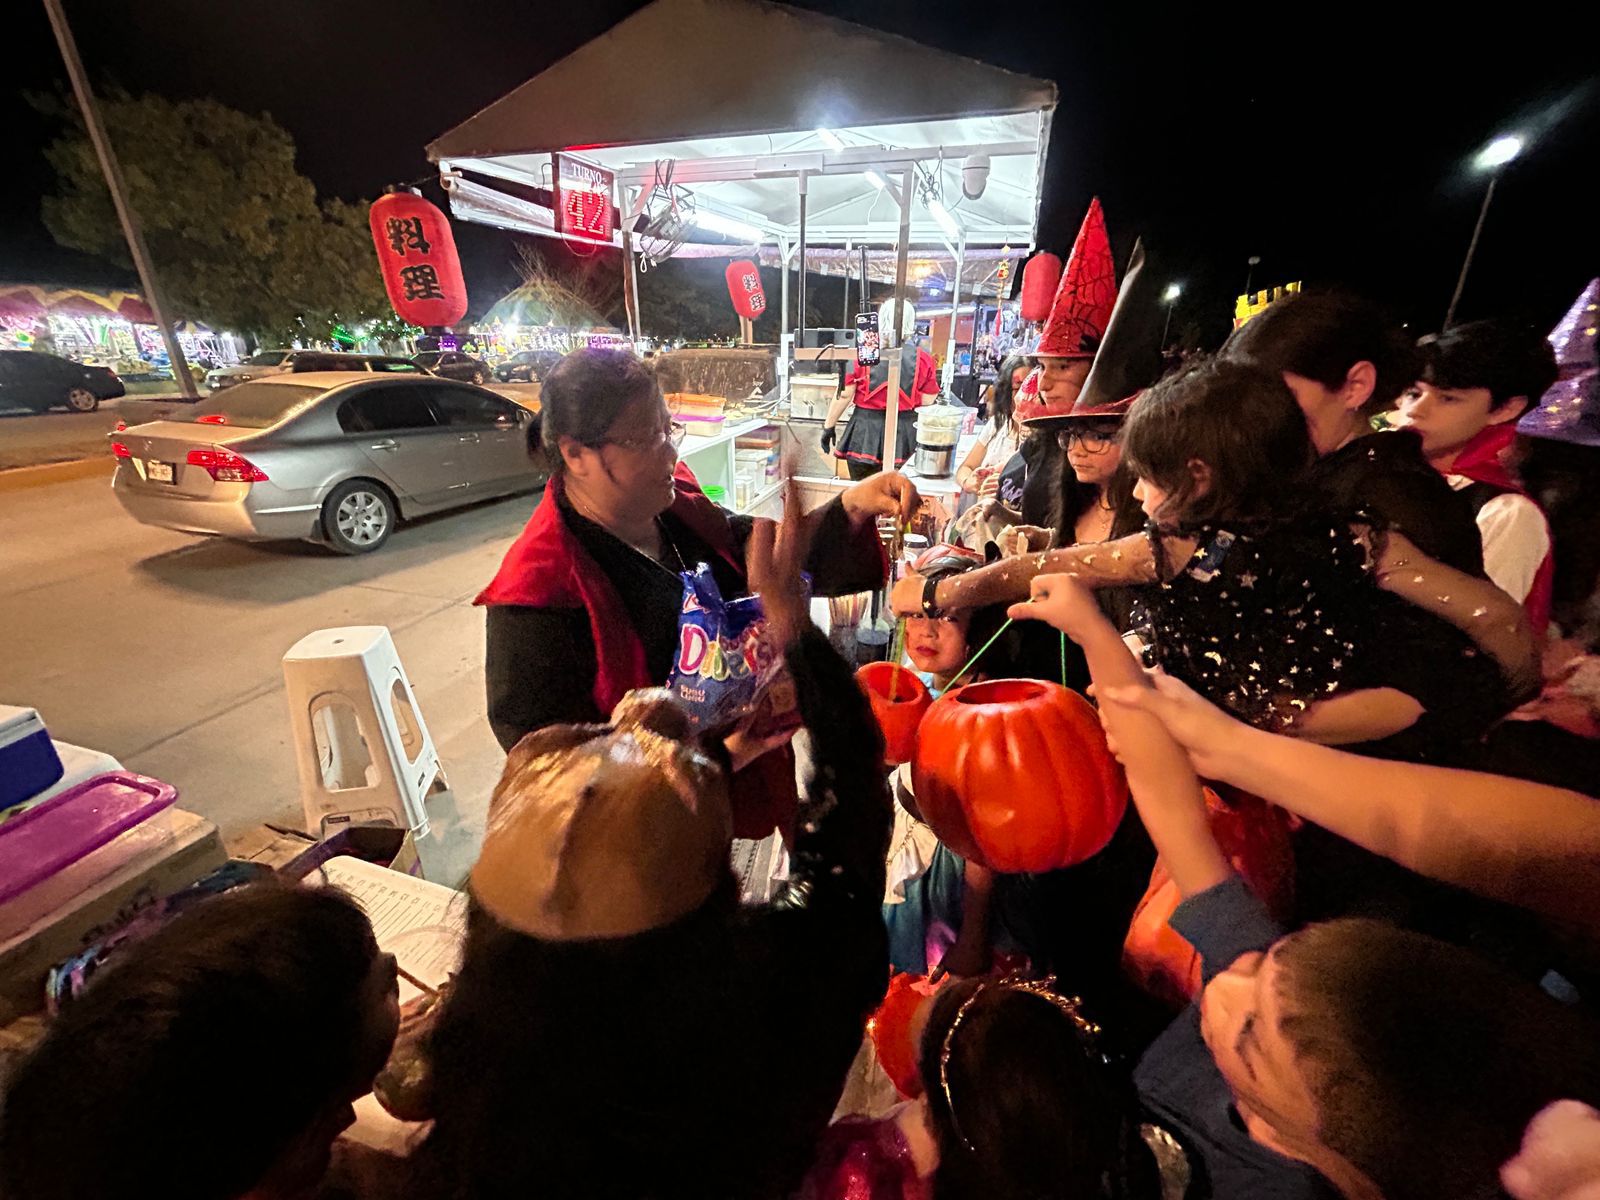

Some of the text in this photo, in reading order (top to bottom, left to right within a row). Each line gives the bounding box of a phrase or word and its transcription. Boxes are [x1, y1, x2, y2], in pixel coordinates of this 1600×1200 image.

[571, 162, 602, 184] TURNO
[568, 189, 604, 234] 42
[386, 216, 446, 301] 料理
[742, 272, 766, 311] 料理
